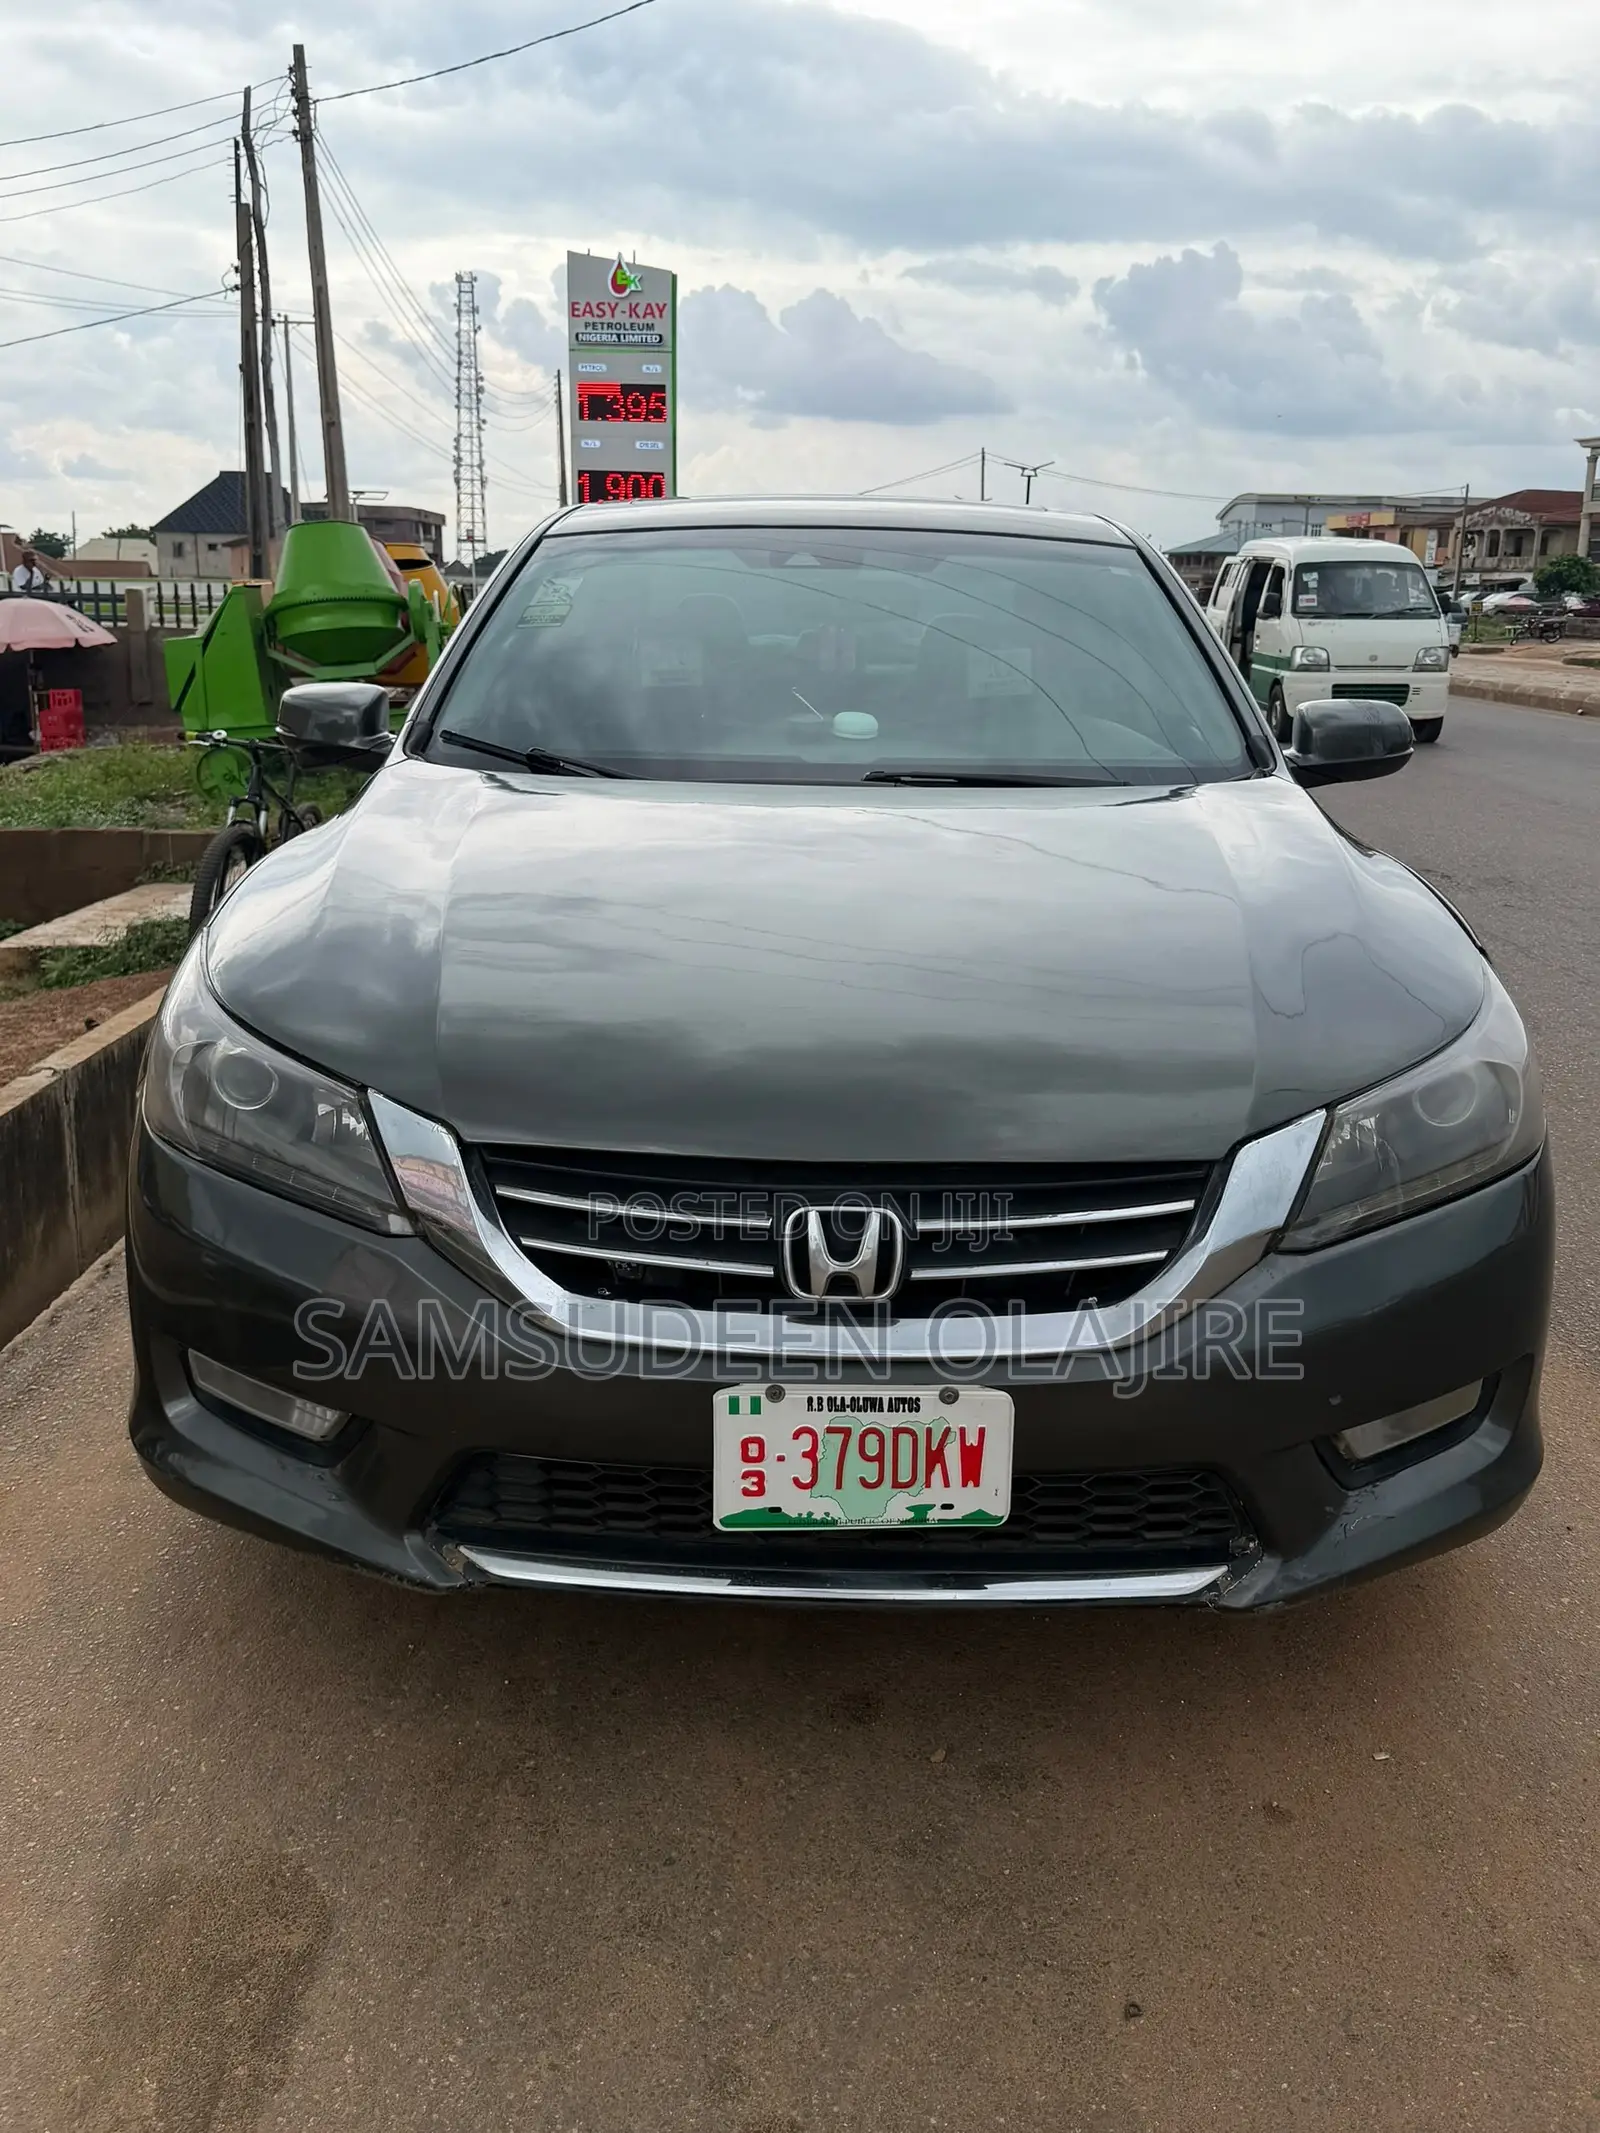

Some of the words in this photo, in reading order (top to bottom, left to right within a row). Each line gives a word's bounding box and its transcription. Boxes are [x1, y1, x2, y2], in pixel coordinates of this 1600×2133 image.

[570, 301, 668, 319] EASY-KAY
[584, 321, 655, 332] PETROLEUM
[579, 333, 618, 342] NIGERIA
[621, 334, 660, 343] LIMITED
[827, 1396, 884, 1413] OLA-OLUWA
[887, 1397, 921, 1413] AUTOS
